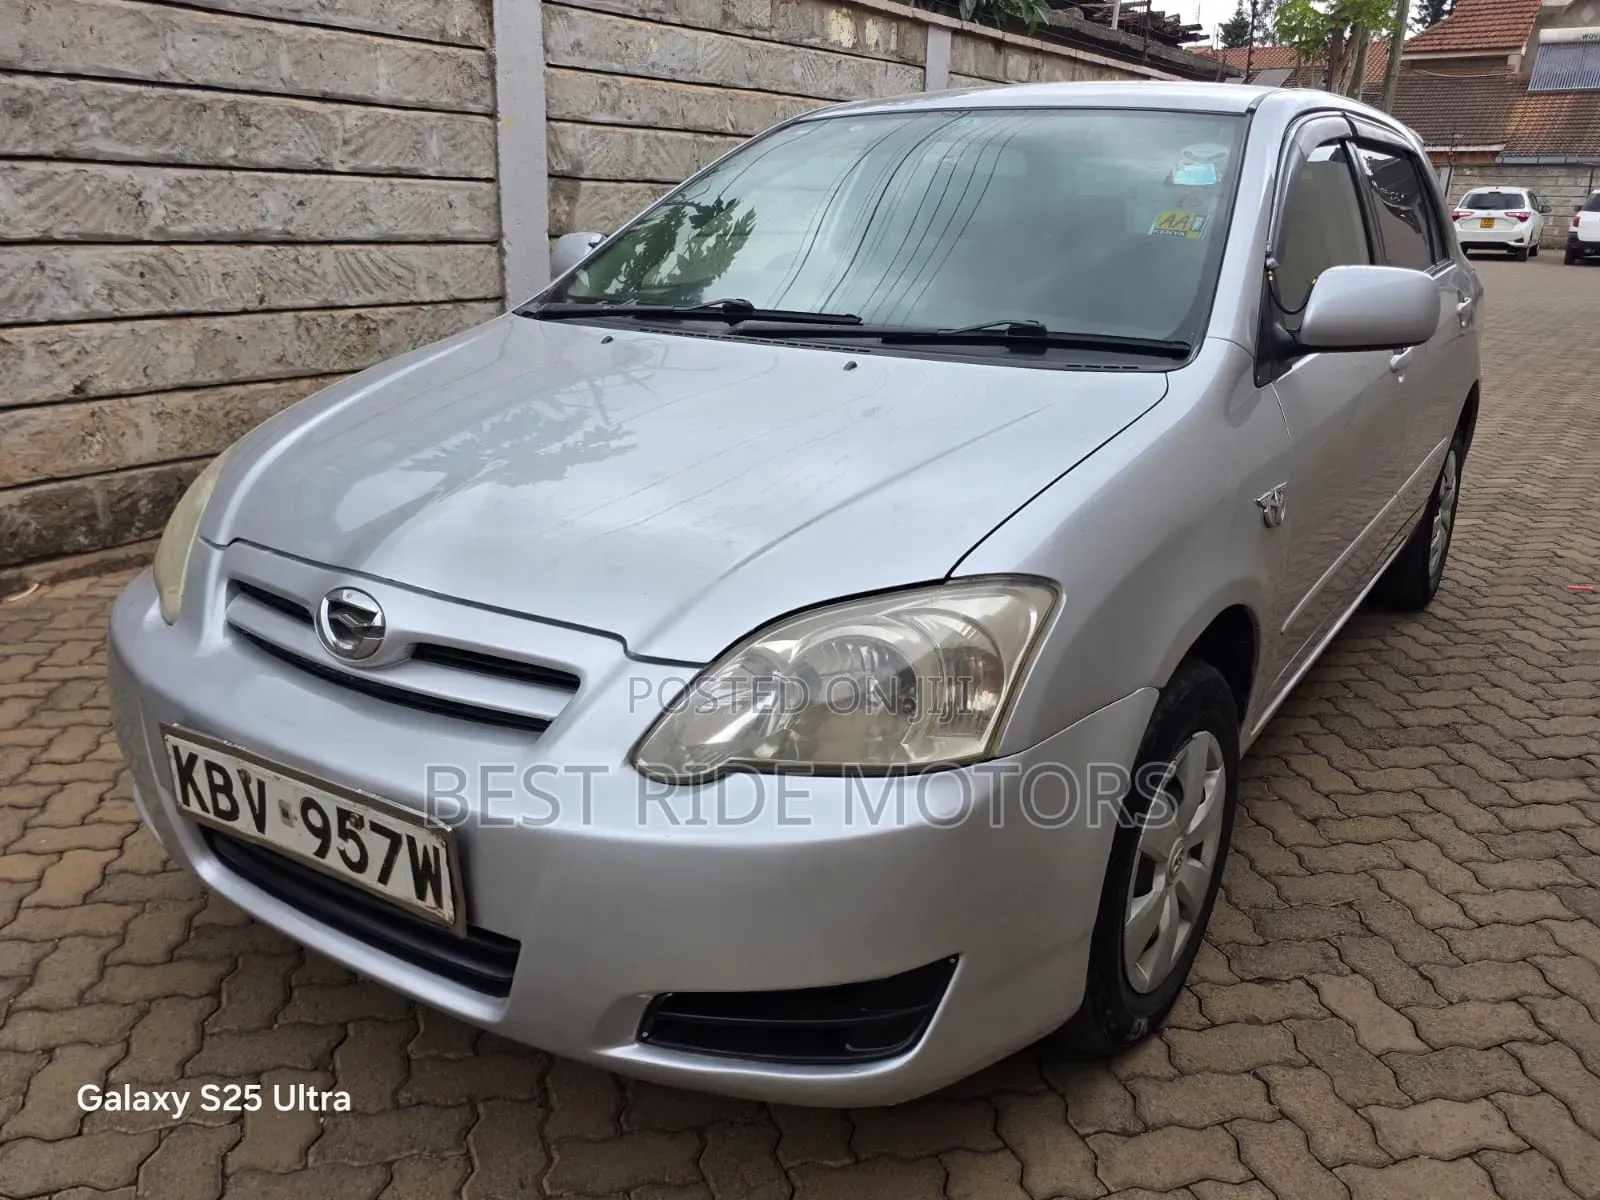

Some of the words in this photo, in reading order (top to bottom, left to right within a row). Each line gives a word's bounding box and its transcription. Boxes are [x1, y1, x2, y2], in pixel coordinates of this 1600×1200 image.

[1158, 213, 1190, 229] AA
[1152, 229, 1185, 237] KENYA
[172, 745, 267, 835] KBV
[300, 796, 444, 910] 957W
